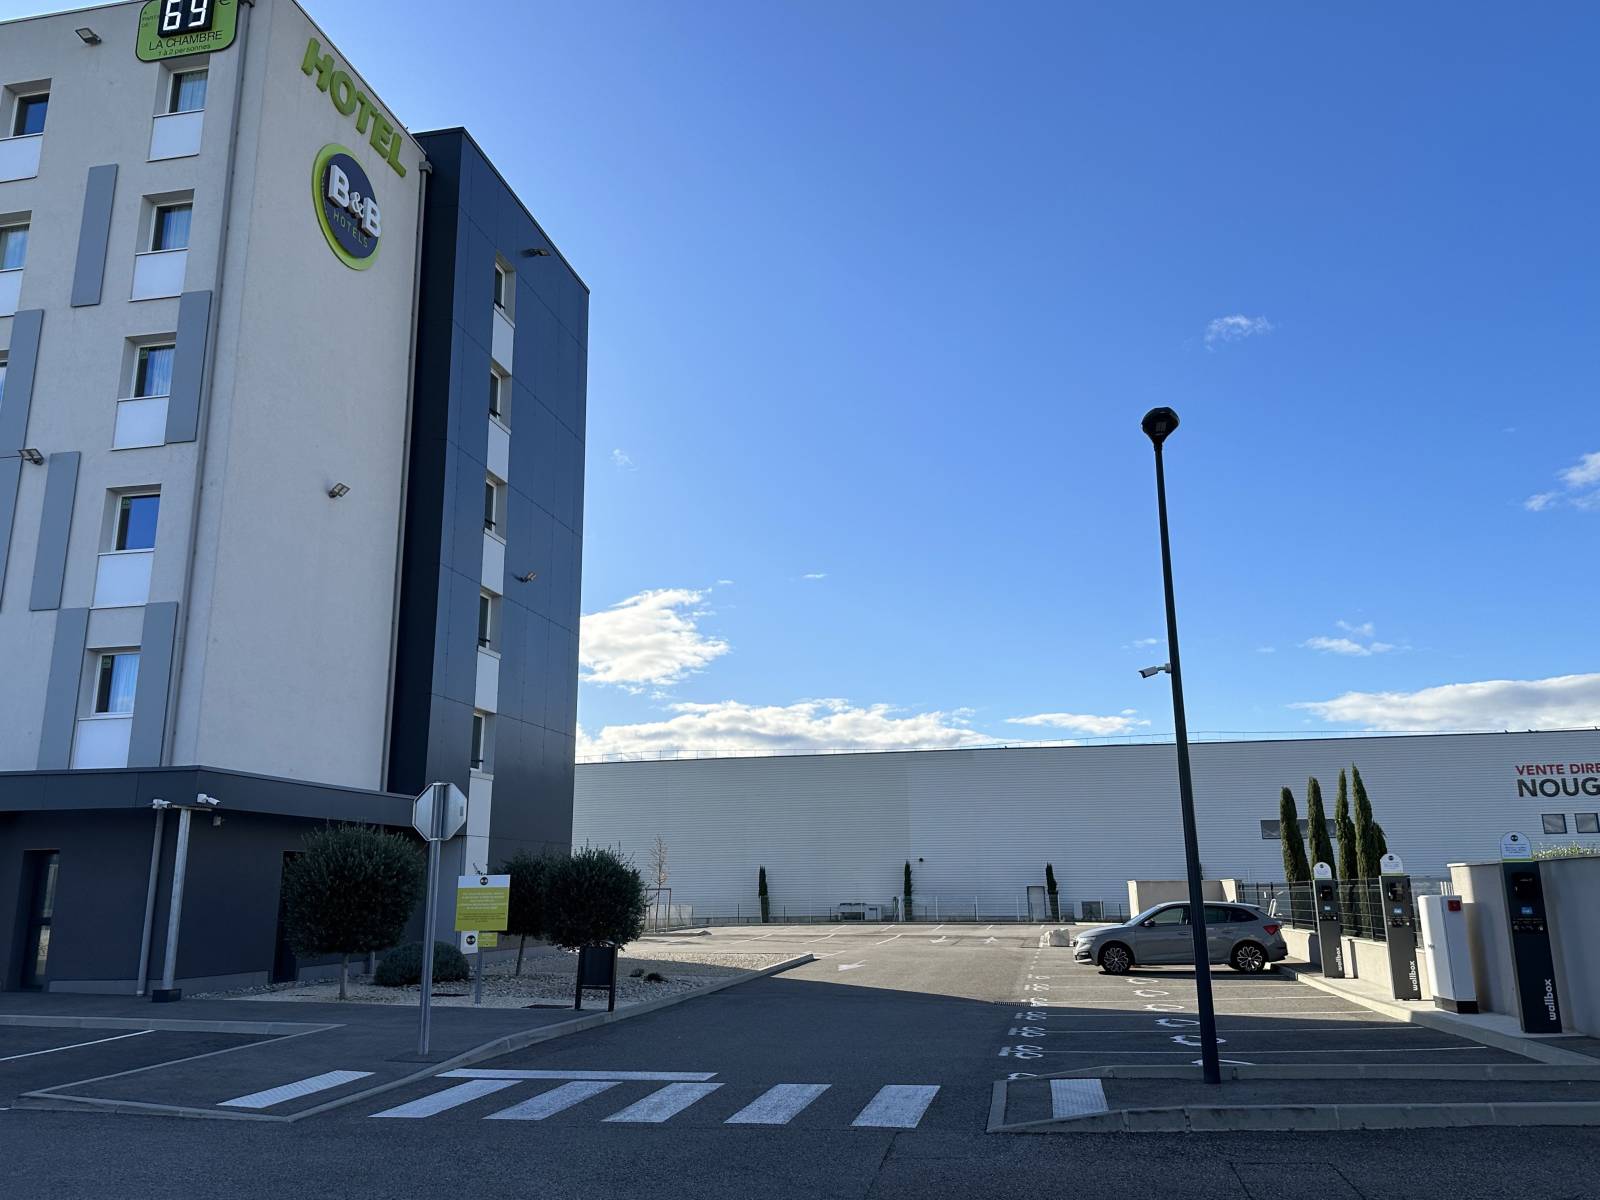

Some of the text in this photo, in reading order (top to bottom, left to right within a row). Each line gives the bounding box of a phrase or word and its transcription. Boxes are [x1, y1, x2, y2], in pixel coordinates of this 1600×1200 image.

[163, 0, 208, 30] 69
[149, 30, 224, 51] LA CHAMBRE
[174, 44, 212, 56] personnes
[301, 37, 407, 178] HOTEL
[328, 164, 382, 238] B&B
[333, 210, 369, 248] HOTELS
[1515, 764, 1565, 776] VENTE
[1517, 776, 1600, 797] NOUG
[1409, 960, 1418, 991] wallbox
[1543, 978, 1557, 1021] wallbox
